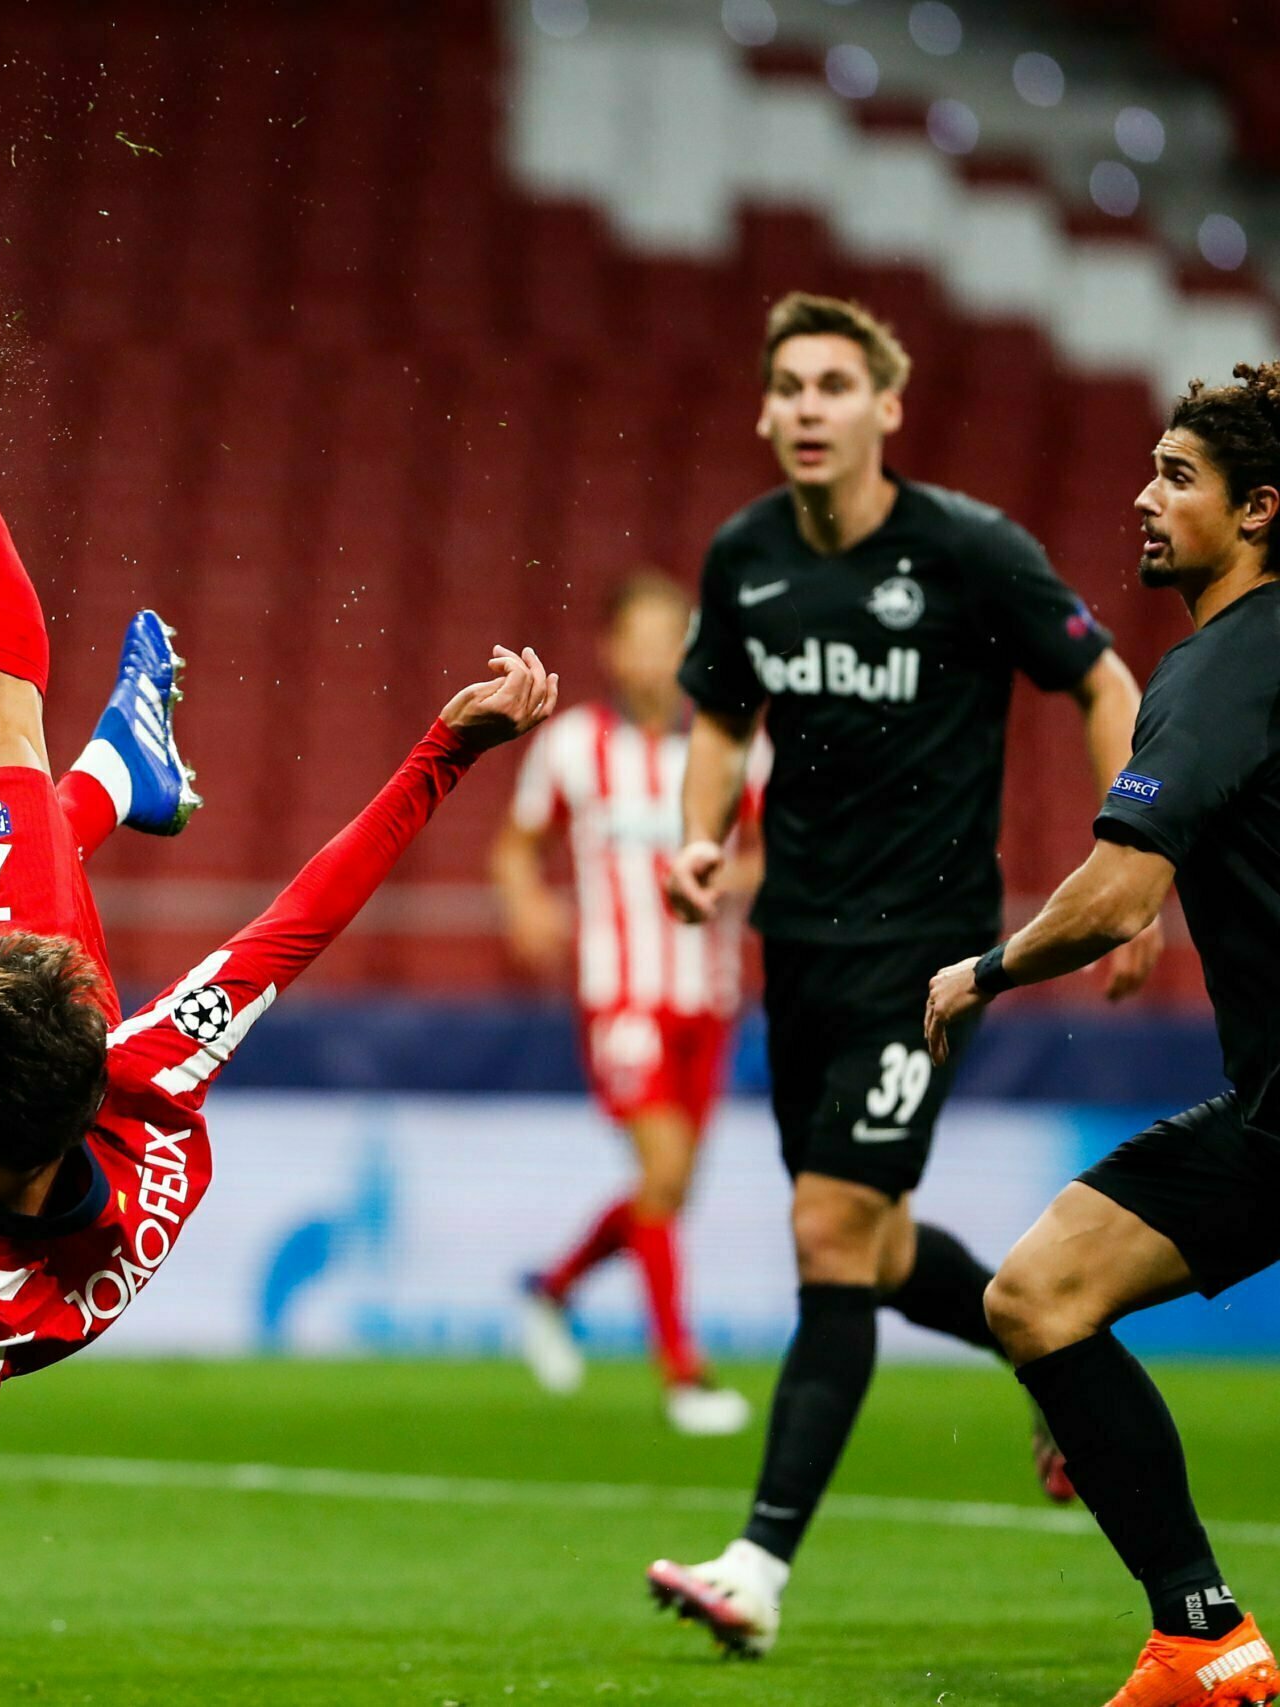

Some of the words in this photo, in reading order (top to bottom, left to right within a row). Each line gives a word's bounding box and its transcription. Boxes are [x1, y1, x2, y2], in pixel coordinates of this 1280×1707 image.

[825, 641, 920, 702] Bull
[866, 1042, 931, 1125] 39
[63, 1218, 170, 1337] JOÃO
[135, 1121, 192, 1225] FÉIX
[1195, 1638, 1270, 1691] PUMA
